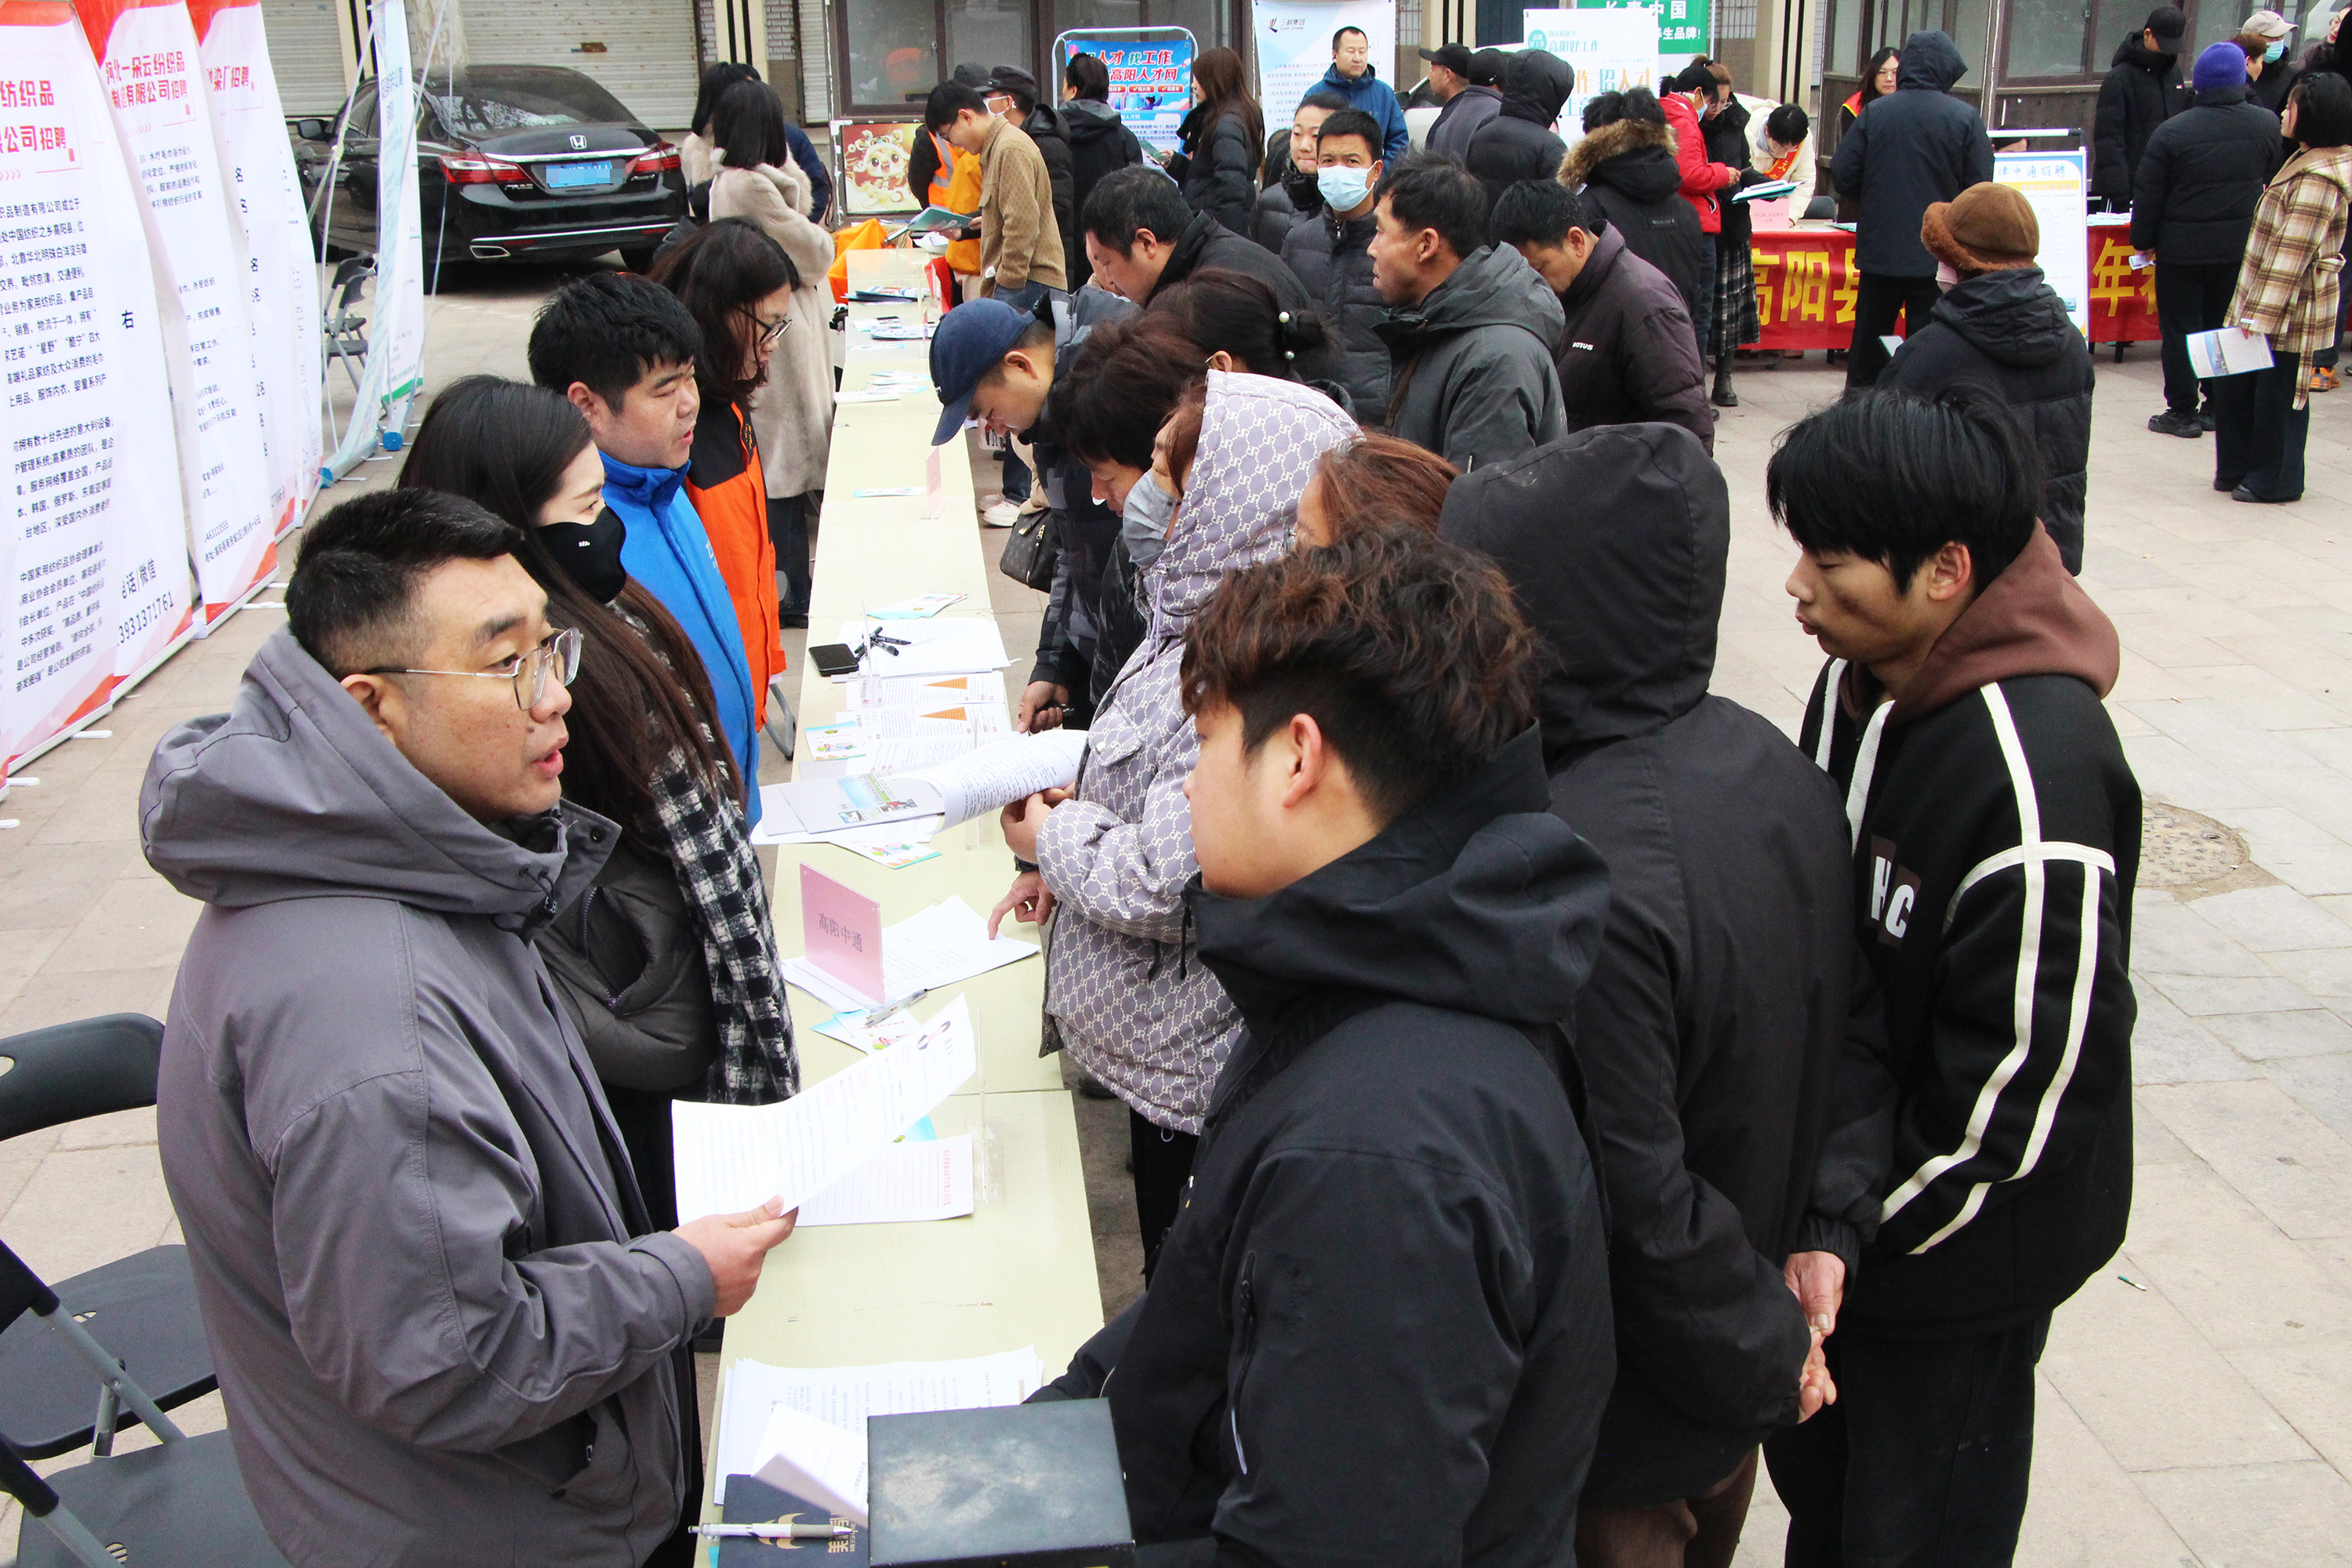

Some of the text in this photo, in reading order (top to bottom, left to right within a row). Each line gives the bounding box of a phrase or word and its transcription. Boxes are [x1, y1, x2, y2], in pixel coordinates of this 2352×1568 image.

[1129, 50, 1173, 65] 找工作
[1549, 39, 1599, 53] 高阳好工作
[1110, 68, 1178, 81] 高阳人才网
[1600, 68, 1652, 92] 招人才
[0, 80, 55, 108] 纺织品
[111, 79, 188, 110] 制造有限公司招聘
[0, 125, 67, 154] 公司招聘
[122, 309, 134, 329] 右
[117, 590, 174, 647] 3931371761
[818, 912, 863, 953] 高阳中通
